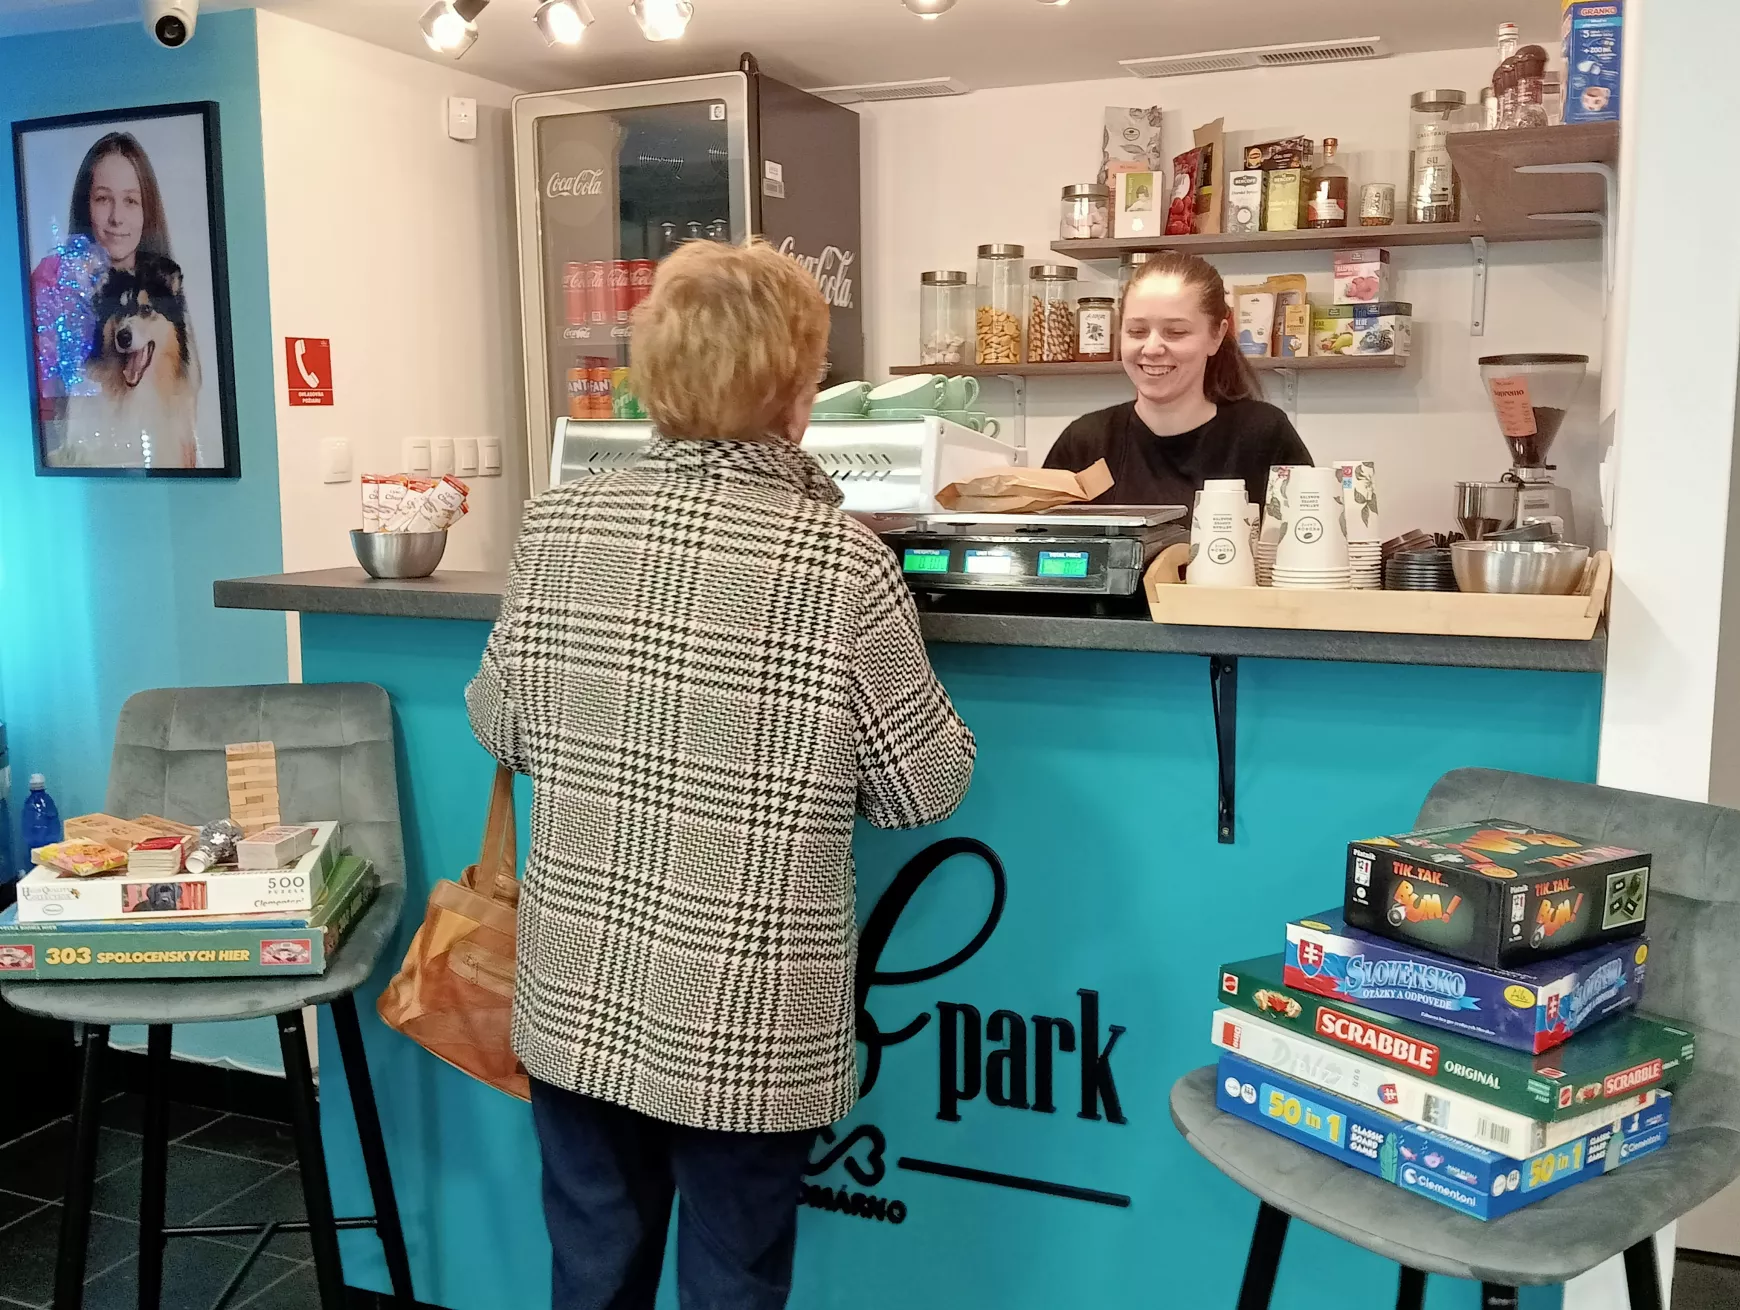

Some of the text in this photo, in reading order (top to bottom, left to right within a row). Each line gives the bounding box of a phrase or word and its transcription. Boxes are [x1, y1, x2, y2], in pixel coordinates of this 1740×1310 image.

[1581, 7, 1617, 16] GRANKO
[547, 168, 604, 198] Coca-Cola
[590, 378, 612, 393] FANT
[268, 876, 304, 889] 500
[1393, 880, 1462, 924] BUM!
[45, 947, 250, 964] 303 SPOLOCENSKYCH HIER
[1345, 953, 1466, 998] SLOVENSKO
[1397, 991, 1404, 999] A
[1405, 992, 1453, 1010] ODPOVEDE
[936, 988, 1129, 1125] park
[1321, 1013, 1437, 1070] SCRABBLE
[1444, 1060, 1501, 1090] ORIGINÁL
[1606, 1062, 1661, 1094] SCRABBLE
[1268, 1090, 1341, 1144] 50 in 1
[1350, 1124, 1384, 1144] CLASSIC
[1351, 1132, 1379, 1150] BOARD
[1628, 1132, 1661, 1152] Clementoni
[1349, 1142, 1378, 1159] GAMES
[1529, 1142, 1582, 1188] 50 in 1
[795, 1182, 908, 1224] OMÁRNO
[1418, 1175, 1476, 1207] Clementoni
